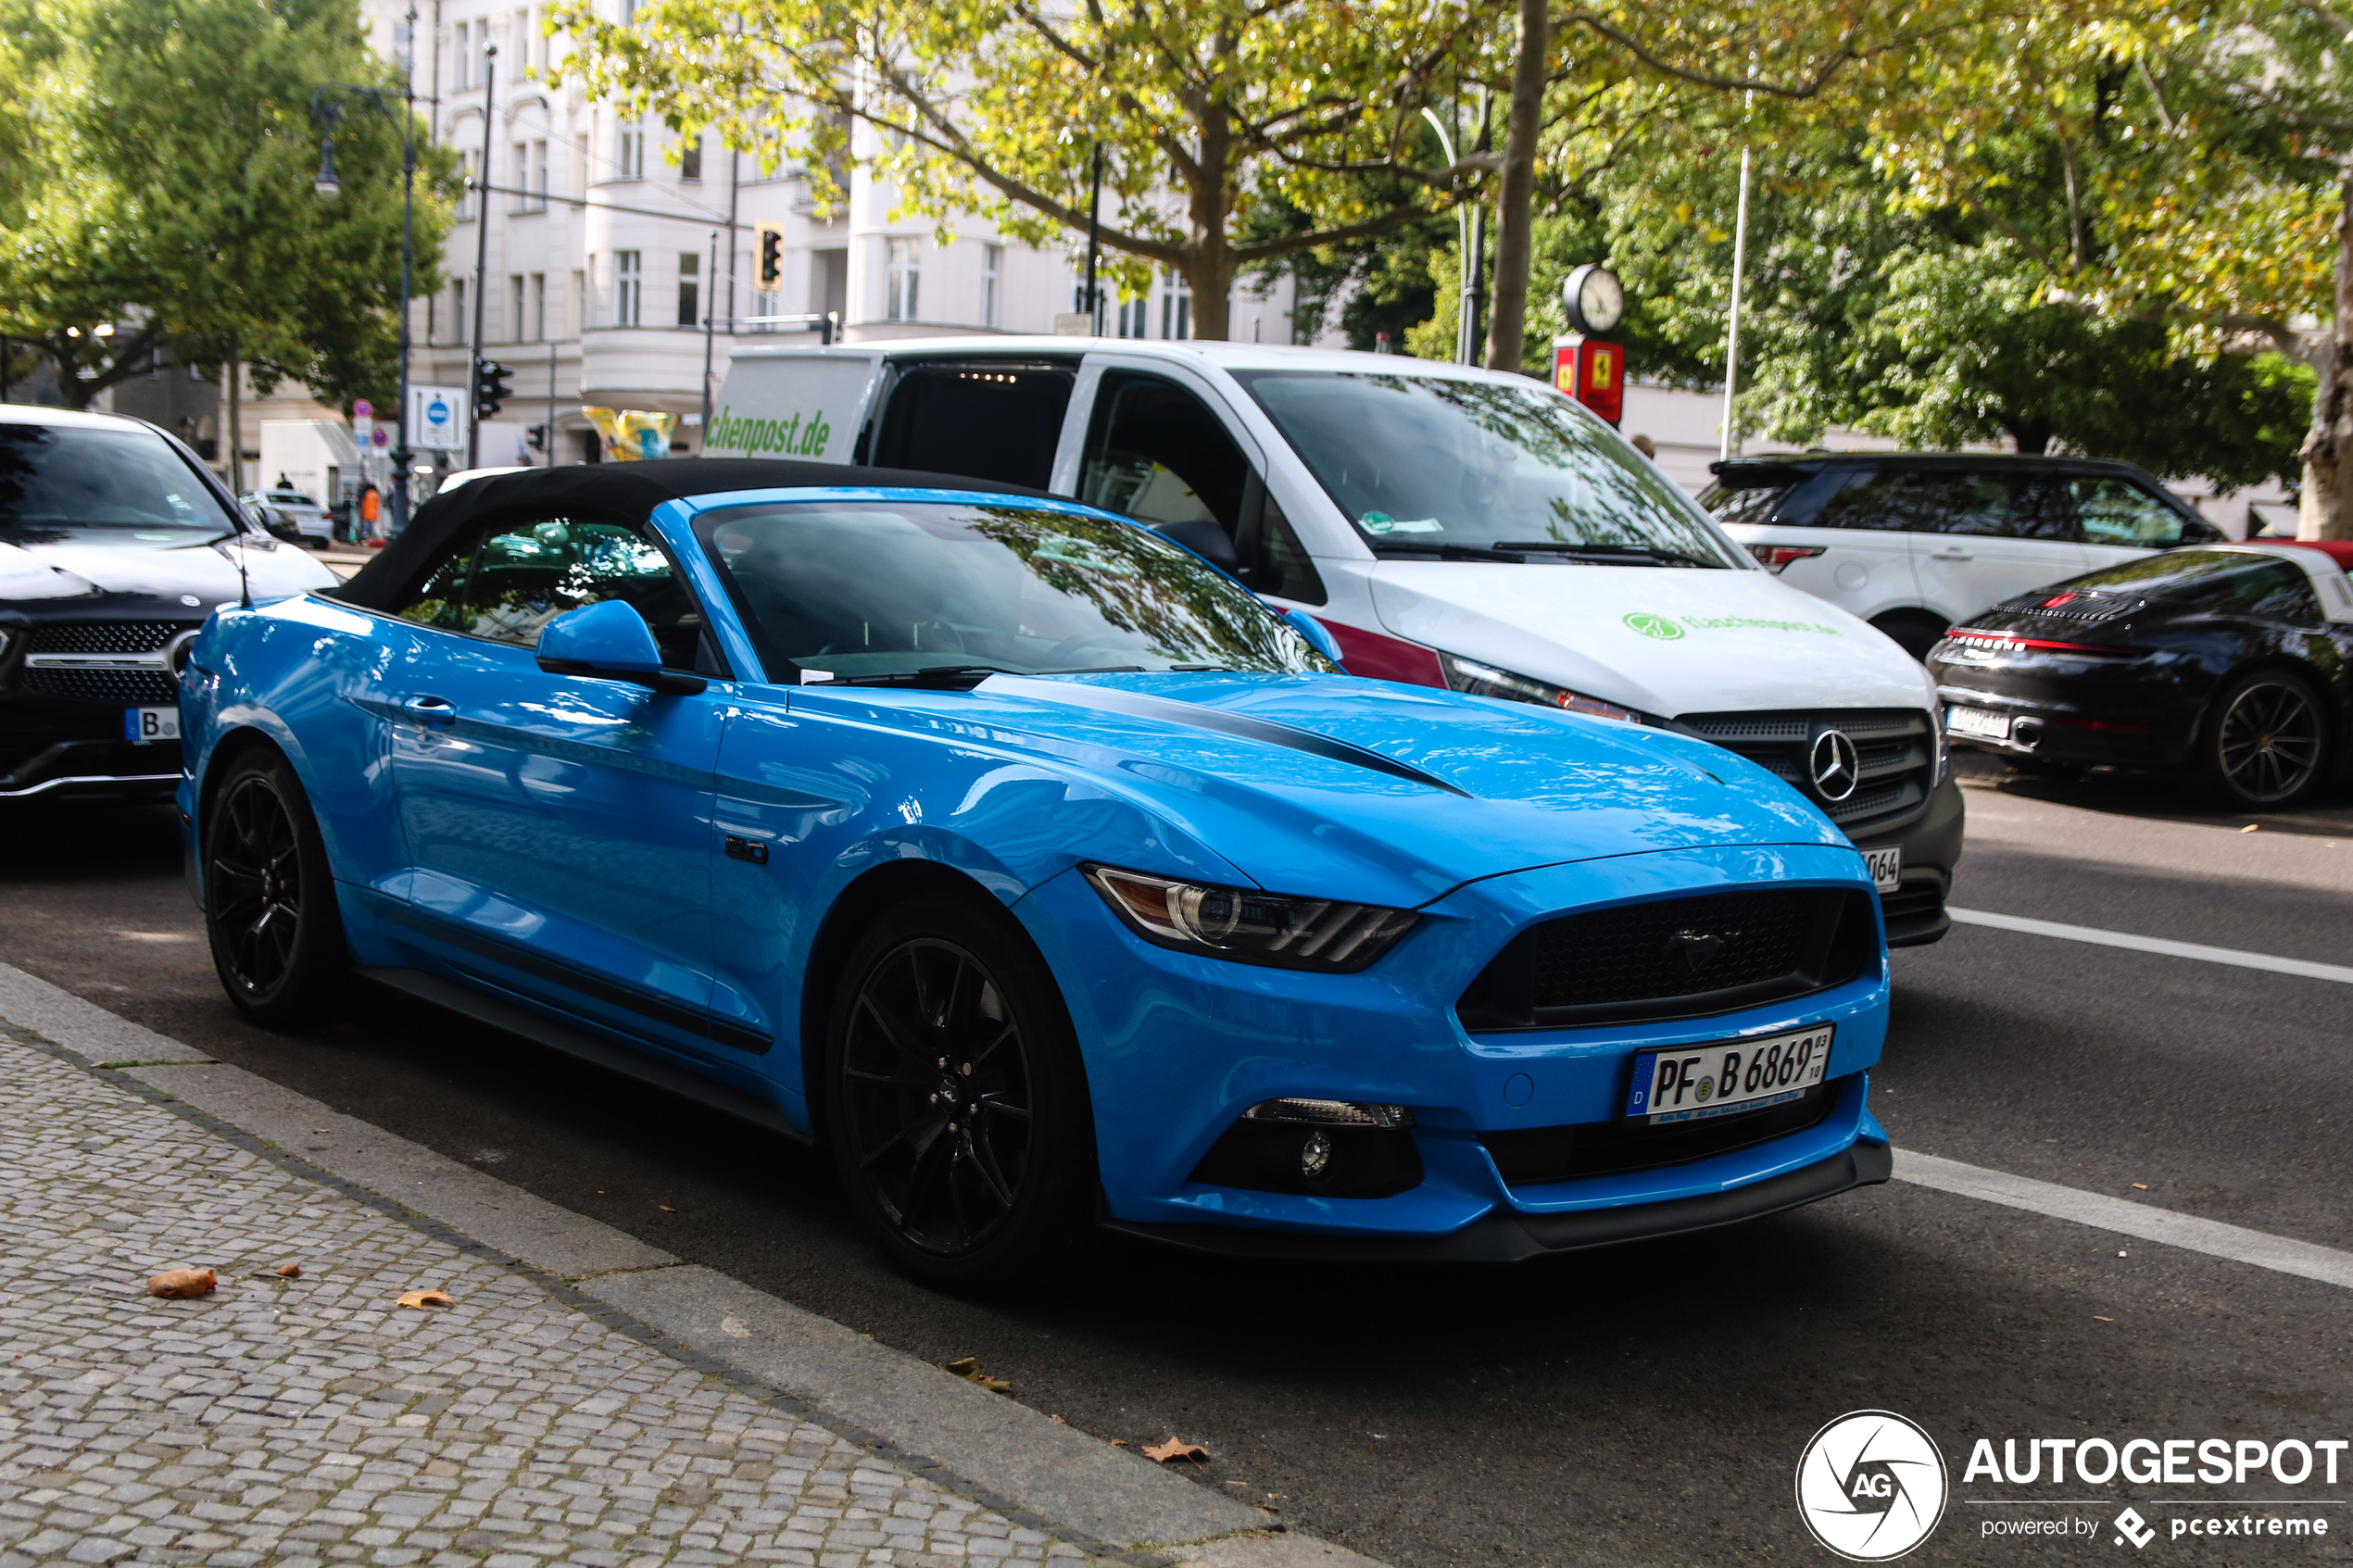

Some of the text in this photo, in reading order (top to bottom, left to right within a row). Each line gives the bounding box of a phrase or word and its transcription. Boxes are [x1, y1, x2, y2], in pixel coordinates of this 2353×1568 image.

[143, 712, 158, 736] B
[1862, 851, 1897, 883] 064
[1815, 1034, 1829, 1048] 03
[1655, 1036, 1813, 1107] PF B 6869
[1809, 1064, 1821, 1080] 10
[1634, 1091, 1643, 1105] D
